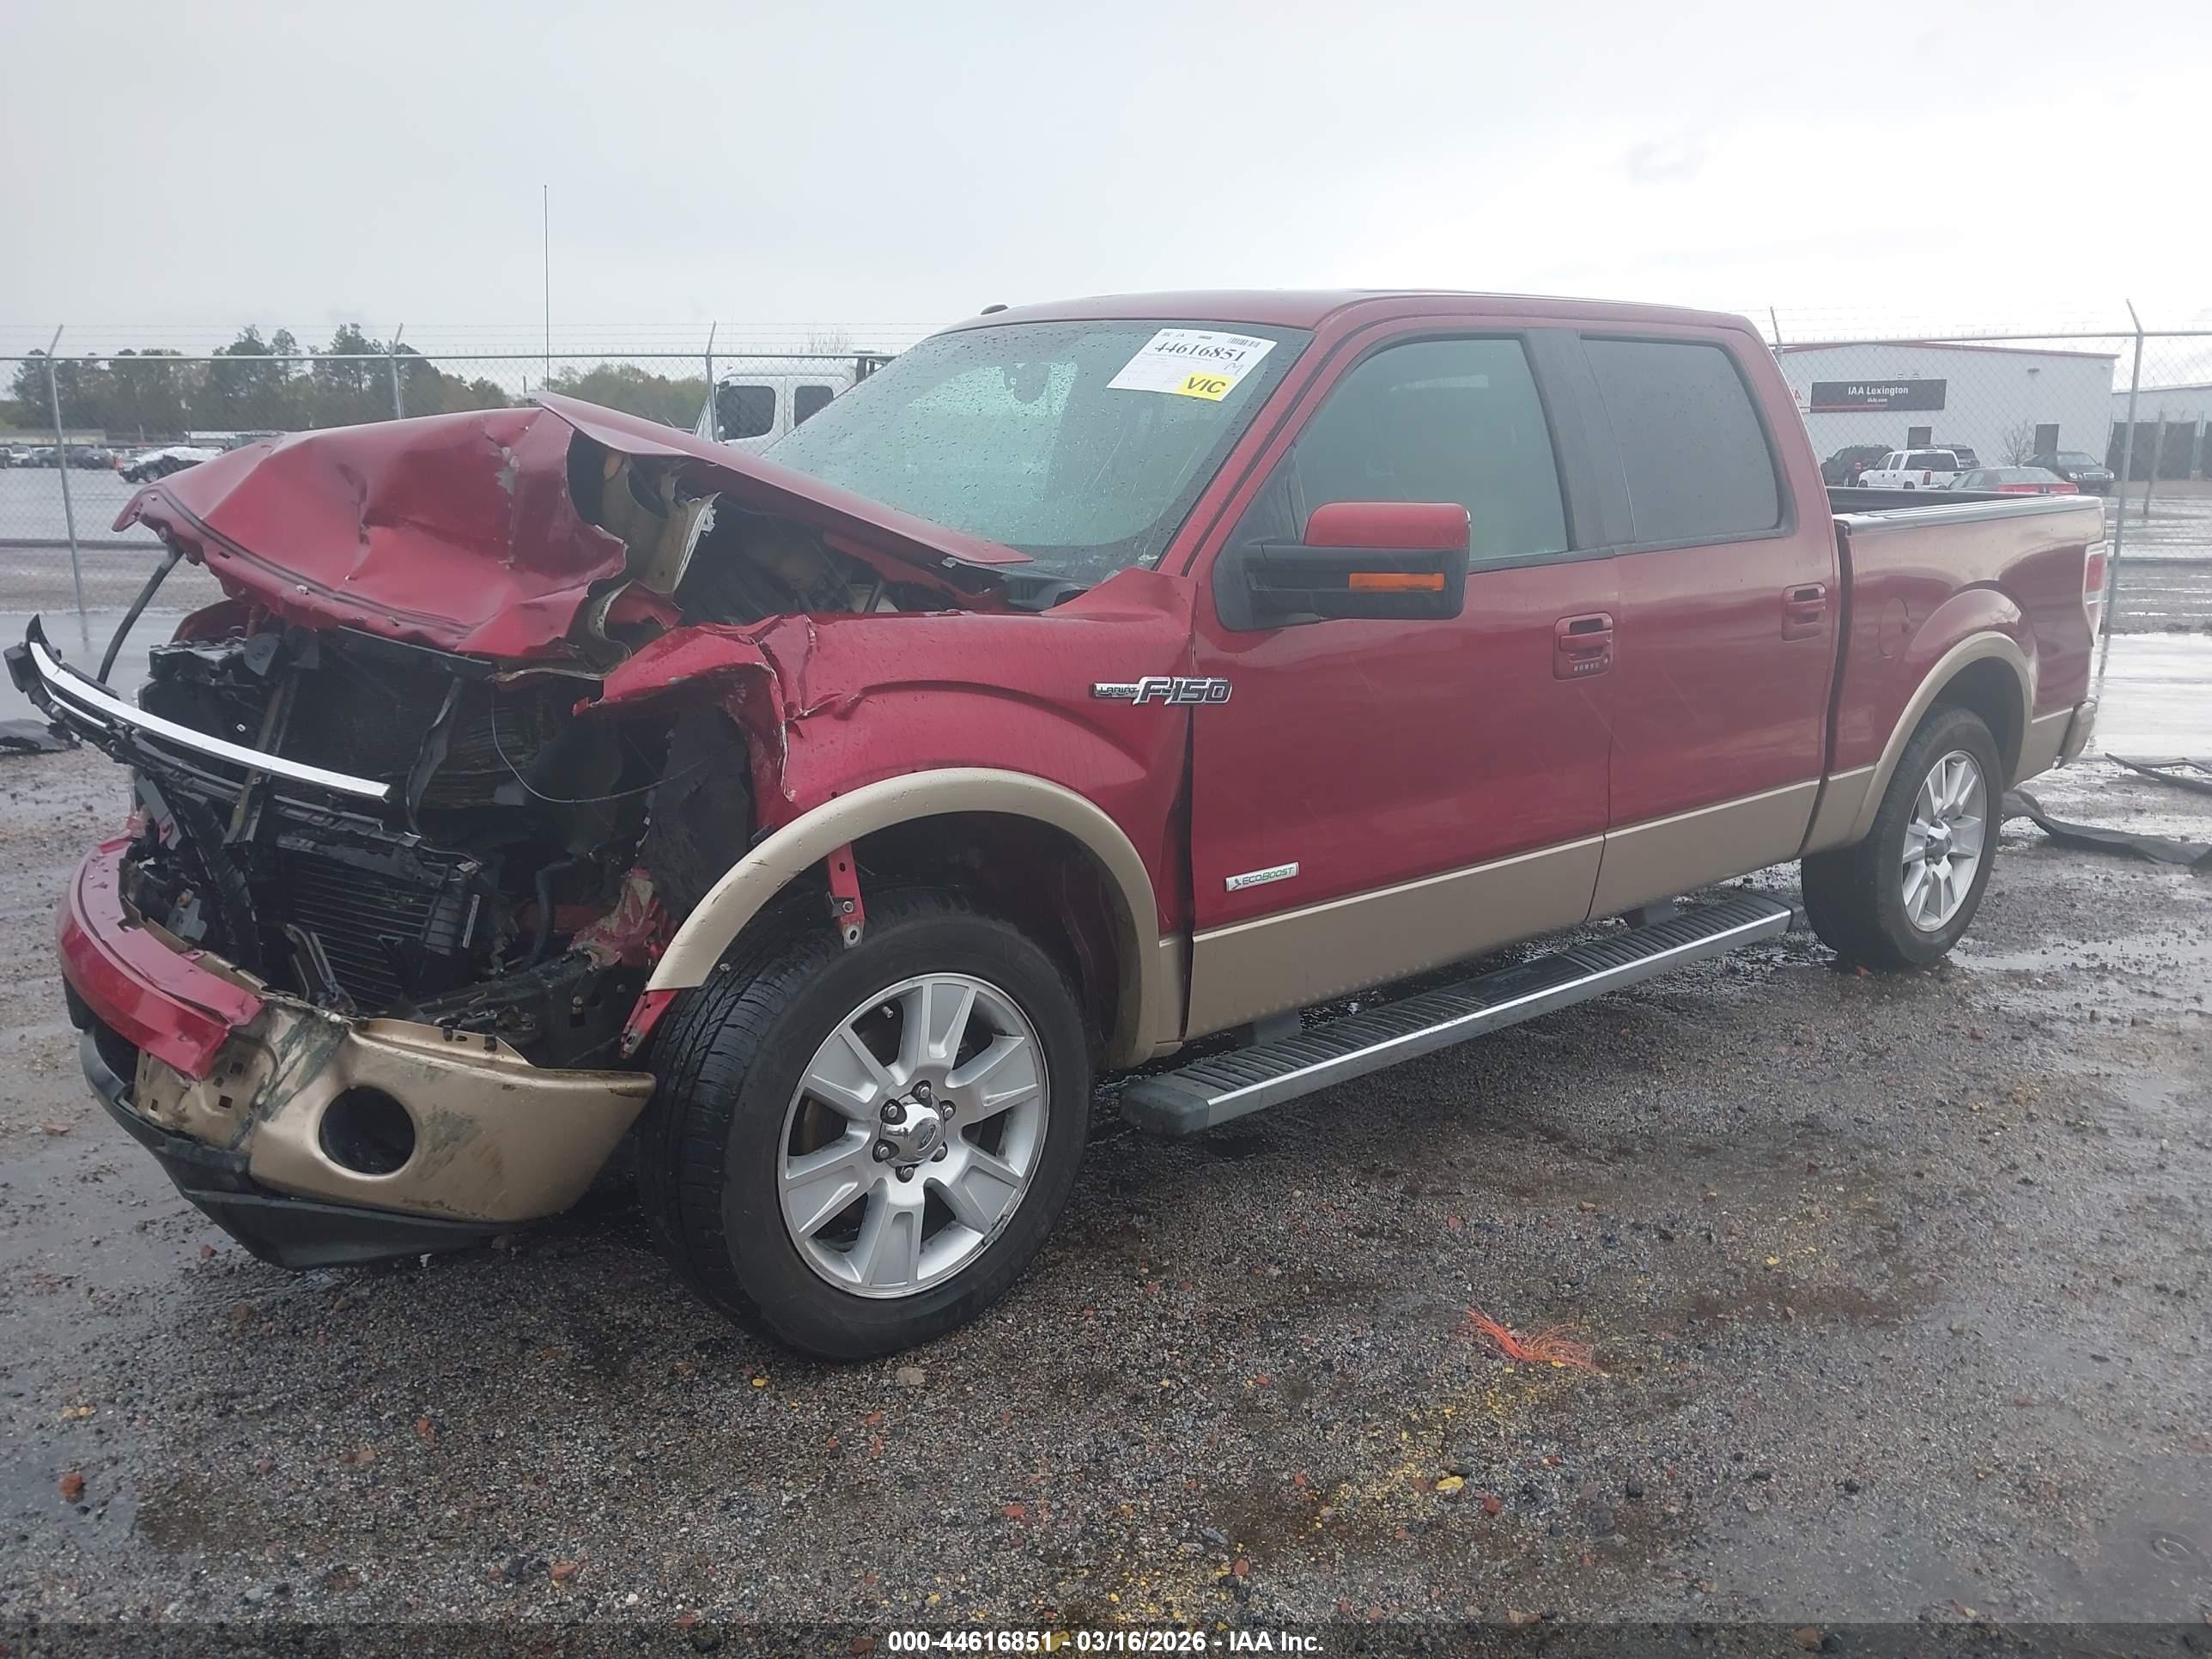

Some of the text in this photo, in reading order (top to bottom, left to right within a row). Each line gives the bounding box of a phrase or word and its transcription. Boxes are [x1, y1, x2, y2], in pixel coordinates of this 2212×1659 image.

[1153, 341, 1248, 362] 44616851
[1187, 377, 1227, 393] VIC
[1847, 385, 1910, 397] IAA Lexington
[1099, 676, 1232, 706] LARIAT F-150
